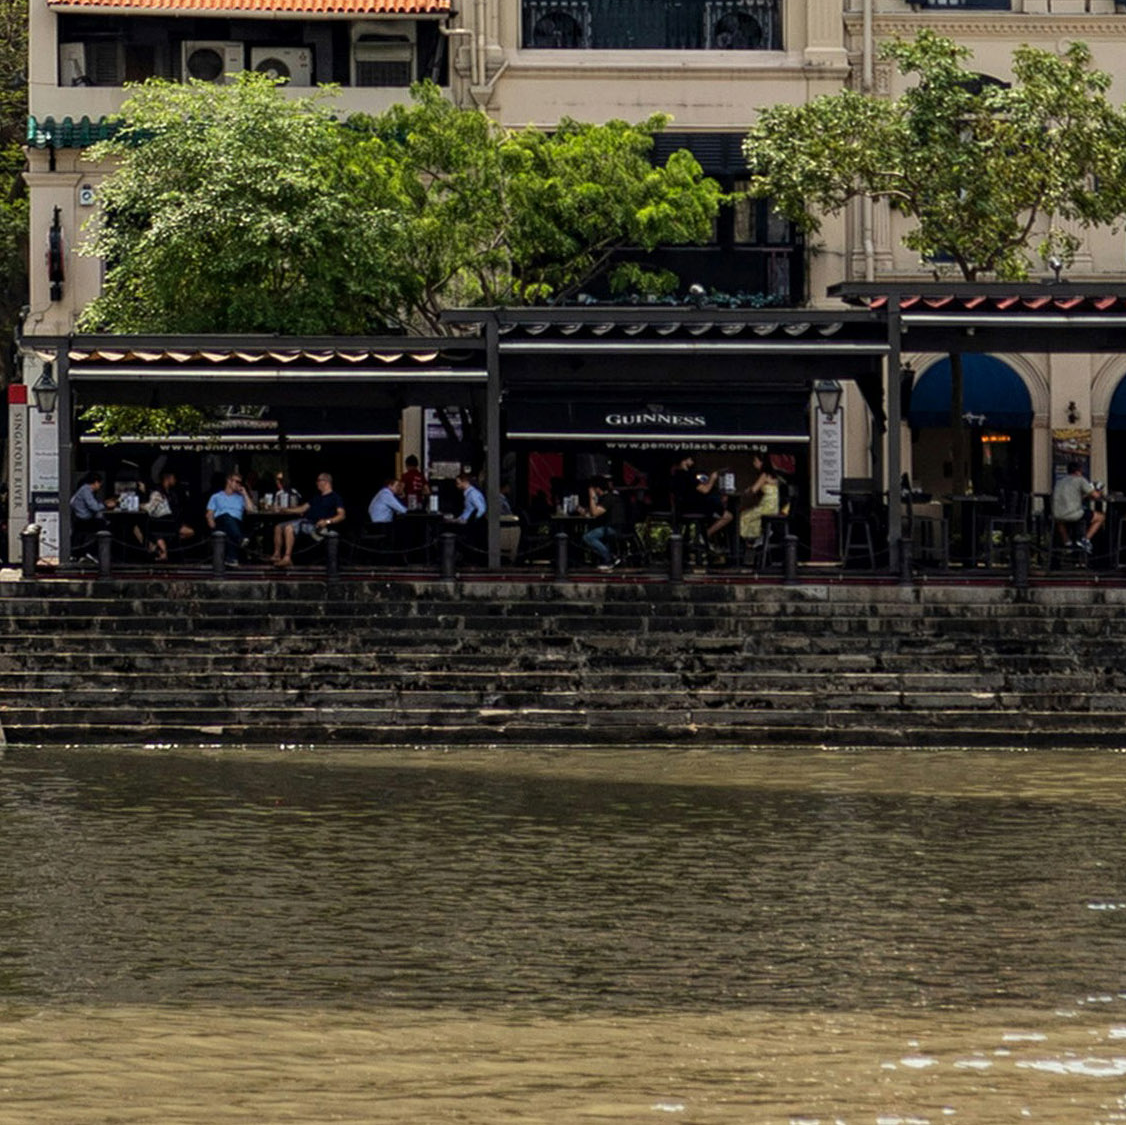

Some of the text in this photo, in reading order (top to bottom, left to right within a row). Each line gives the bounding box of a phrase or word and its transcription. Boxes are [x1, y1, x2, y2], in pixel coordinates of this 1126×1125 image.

[605, 414, 706, 425] GUINNESS
[159, 443, 322, 452] www.pennyblack.cm.sg
[605, 442, 768, 452] www.pennyblack.com.sg
[14, 412, 24, 509] SINGAPORE RIVER
